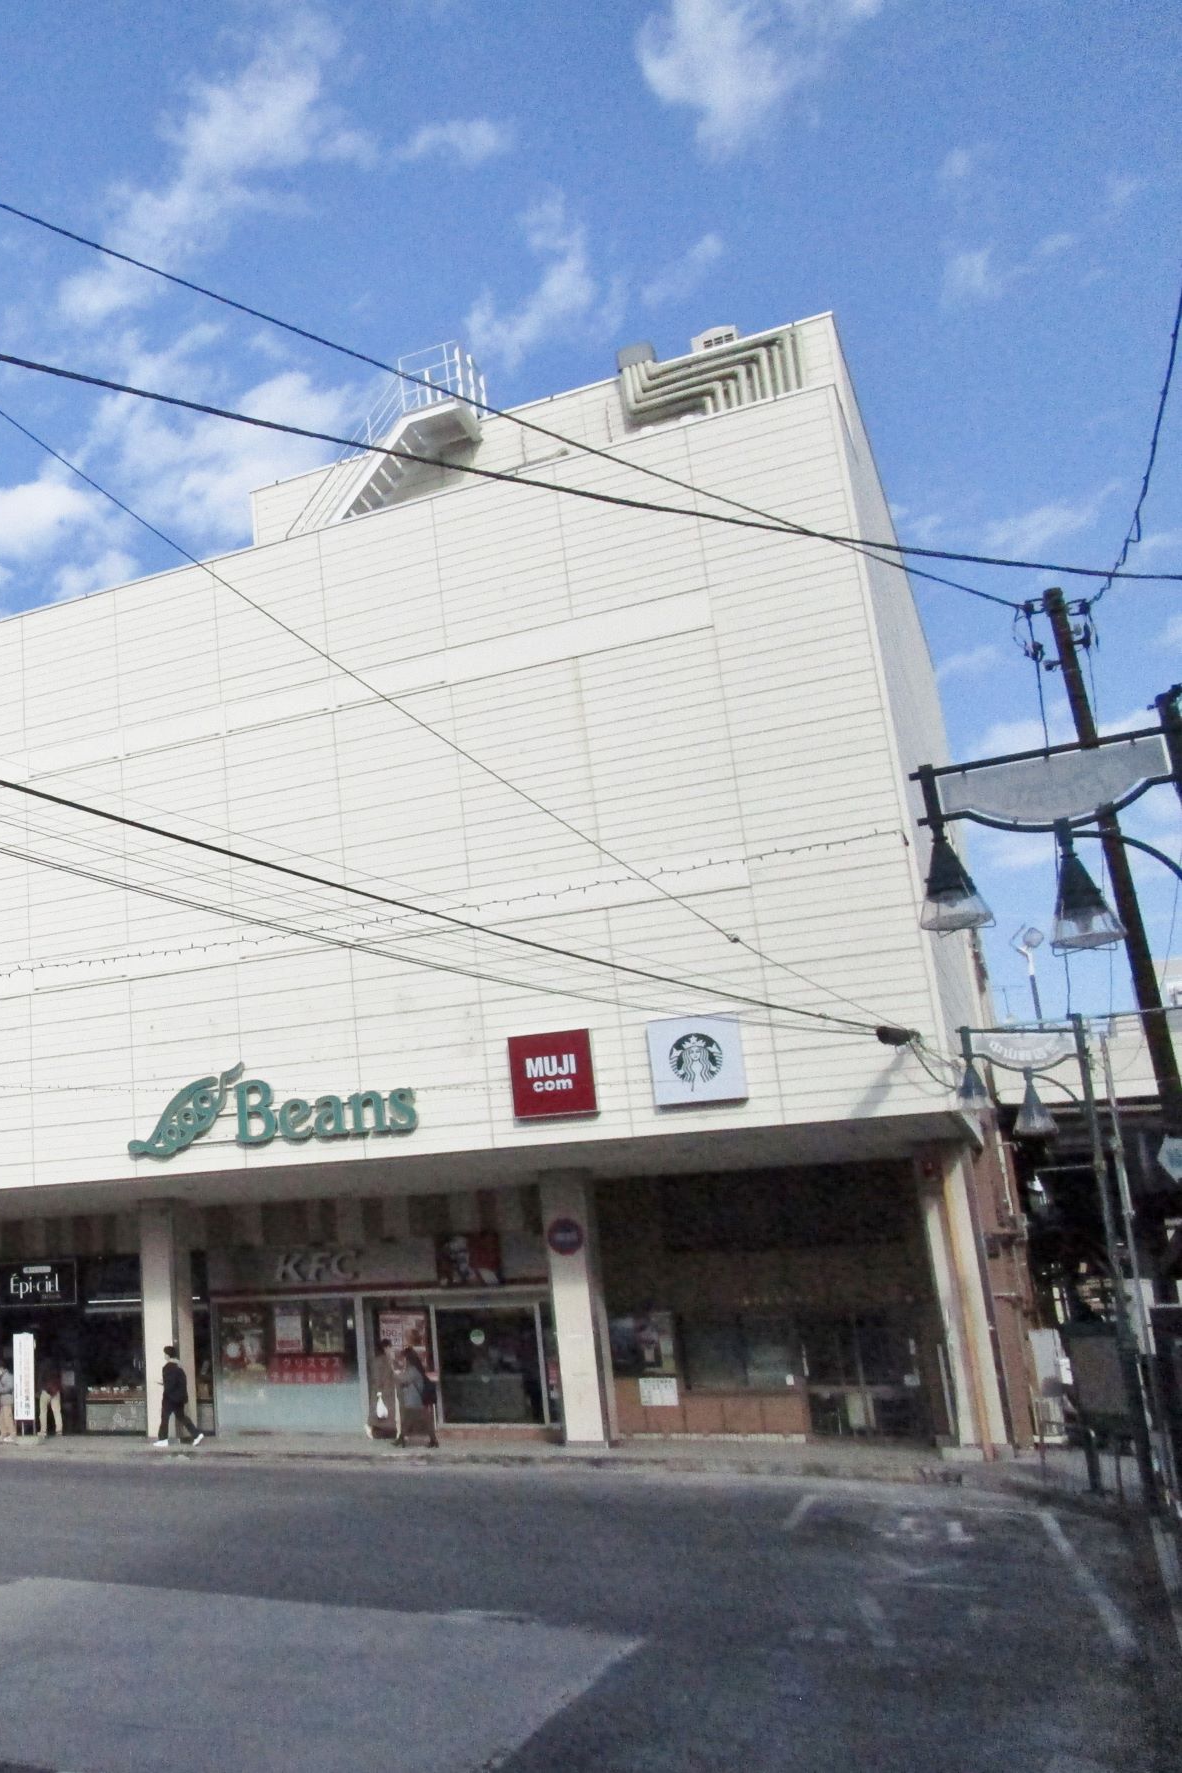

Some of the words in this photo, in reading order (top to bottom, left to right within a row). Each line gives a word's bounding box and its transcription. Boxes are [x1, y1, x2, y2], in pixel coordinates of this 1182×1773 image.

[525, 1053, 577, 1079] MUJI
[532, 1079, 574, 1093] com
[234, 1079, 418, 1143] Beans
[275, 1248, 359, 1283] KFC
